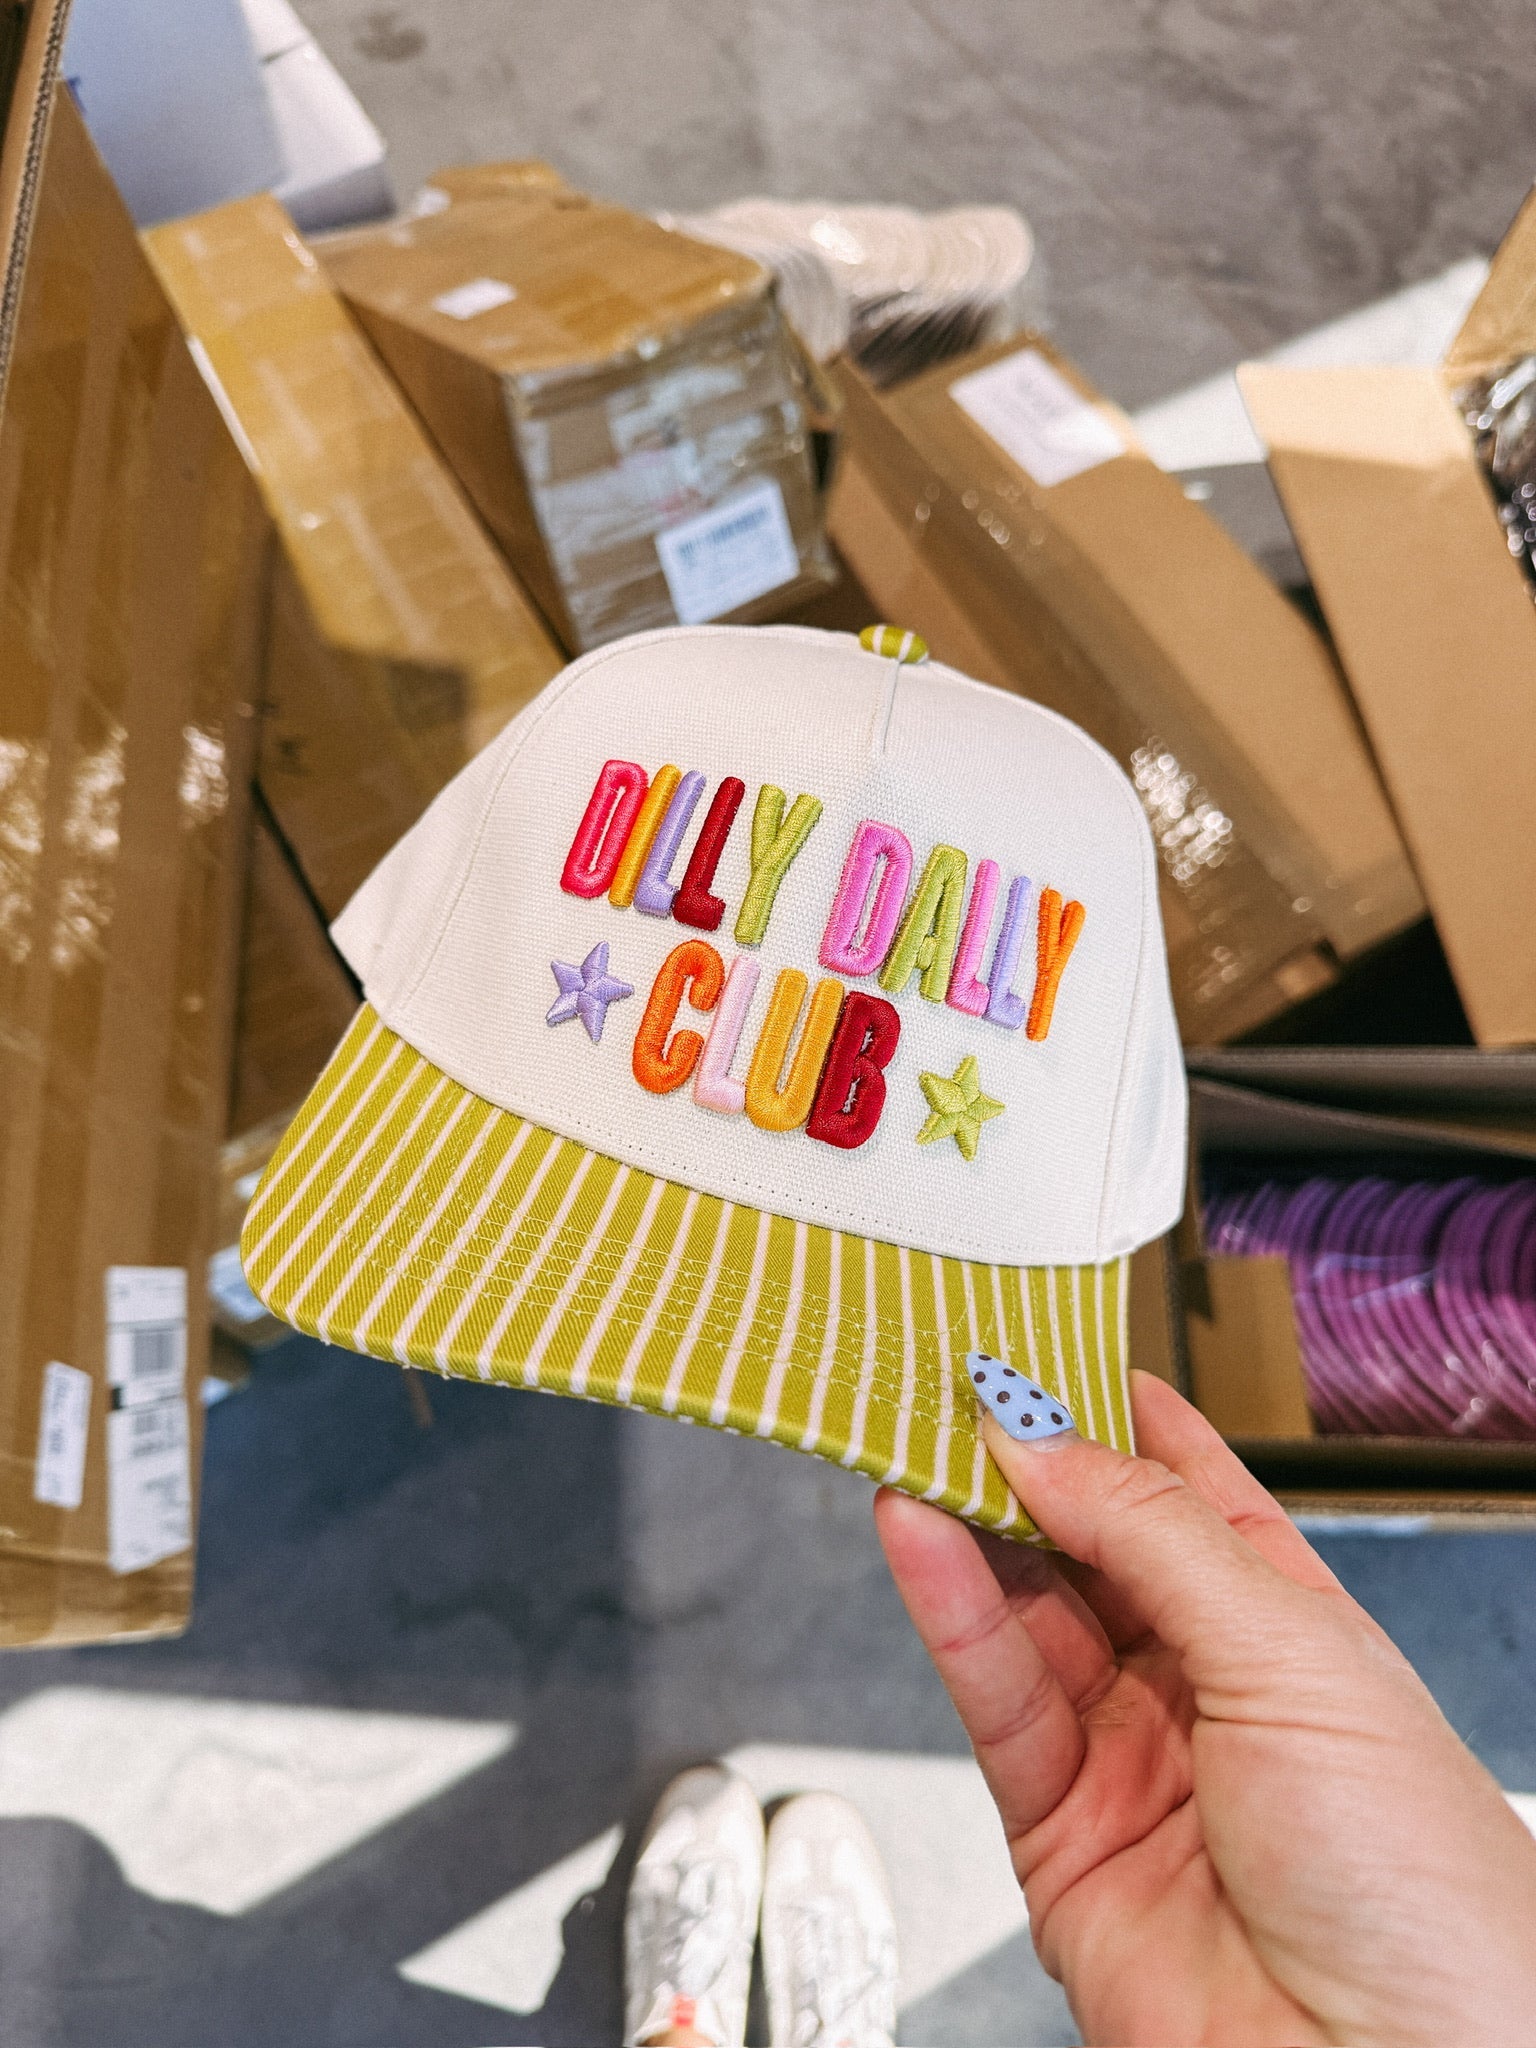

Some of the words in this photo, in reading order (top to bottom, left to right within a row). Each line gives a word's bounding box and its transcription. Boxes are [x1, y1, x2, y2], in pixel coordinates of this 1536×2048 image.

[560, 759, 823, 945] DILLY
[818, 820, 1086, 1042] DALLY
[631, 940, 901, 1149] CLUB
